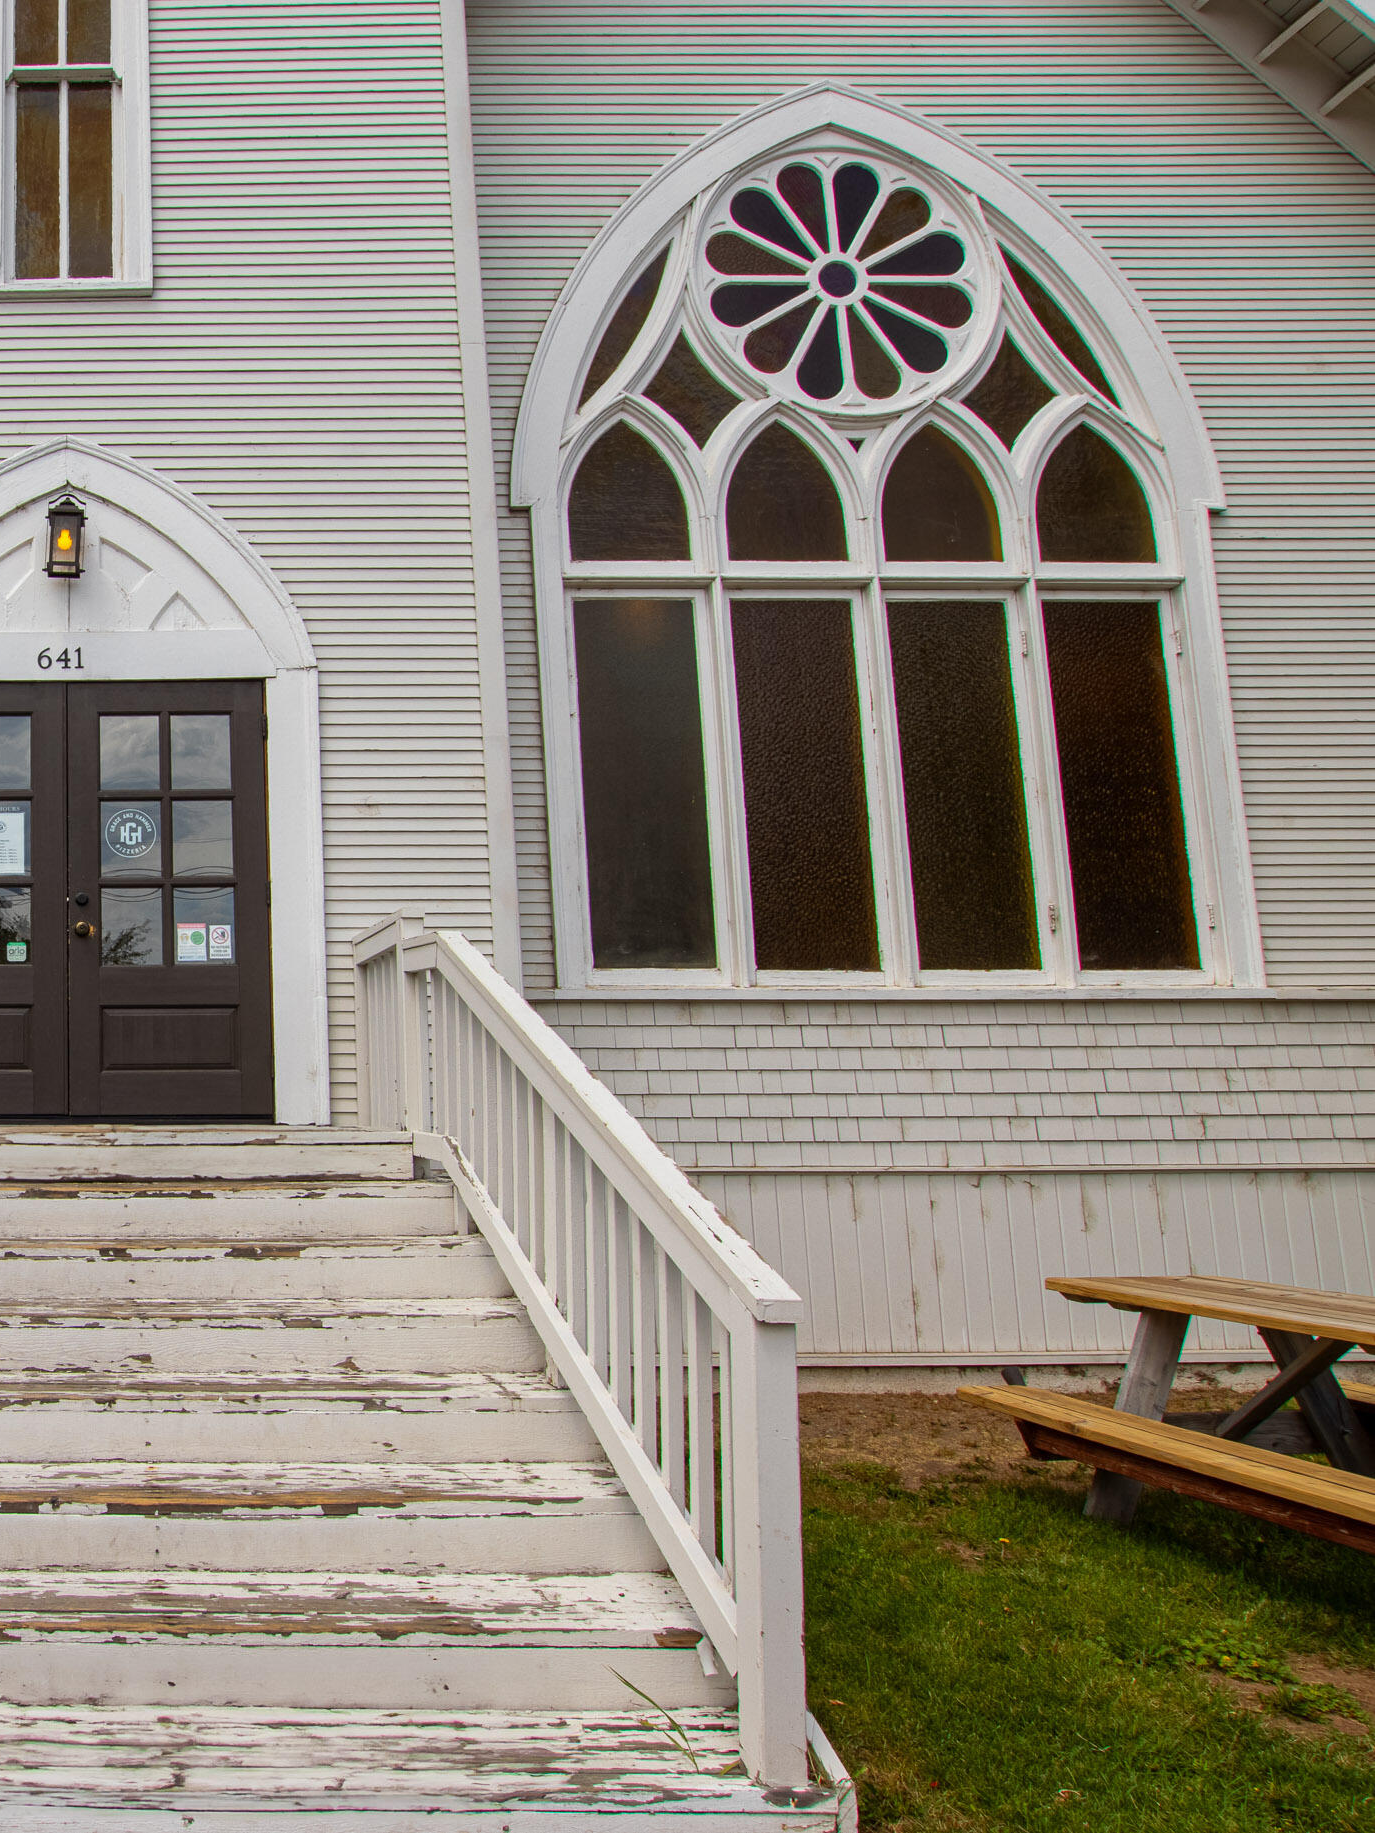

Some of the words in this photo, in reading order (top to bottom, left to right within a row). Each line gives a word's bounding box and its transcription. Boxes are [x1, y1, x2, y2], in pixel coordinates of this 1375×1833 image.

[37, 646, 85, 670] 641
[109, 816, 122, 833] GRACE
[134, 814, 153, 833] HAMMER
[115, 844, 147, 855] PIZZERIA
